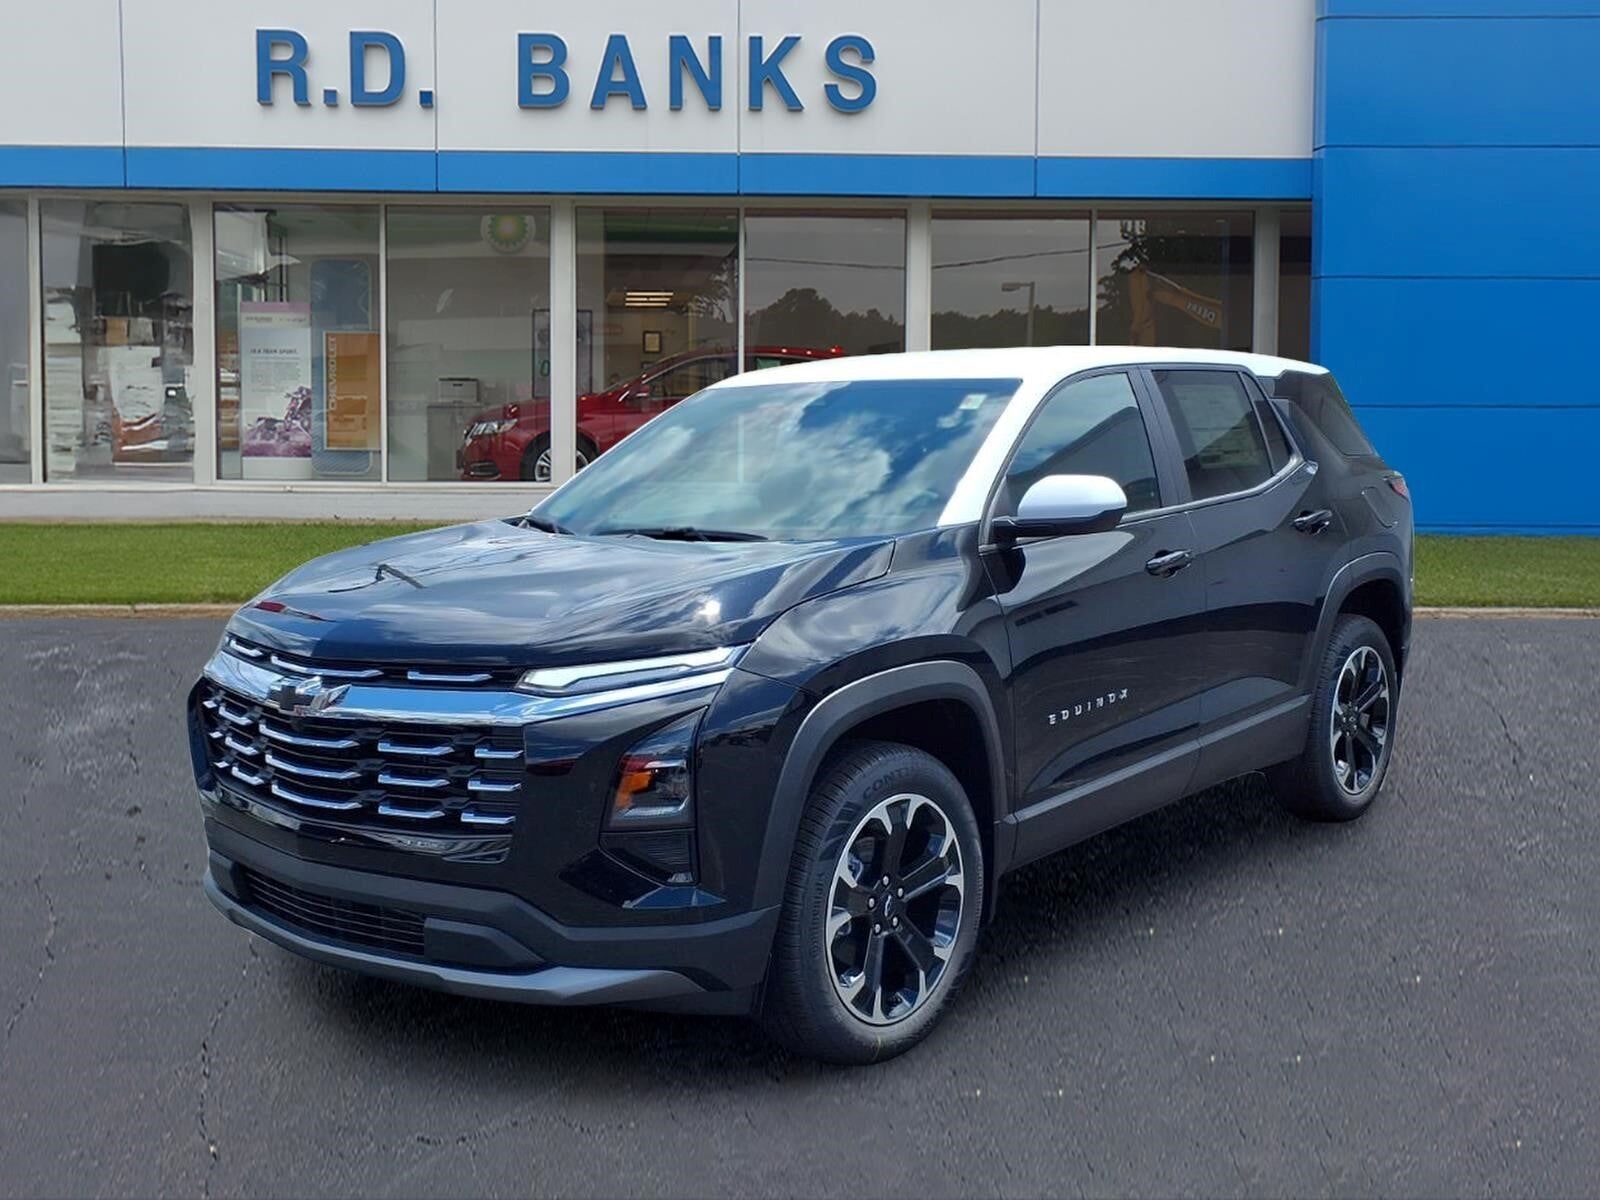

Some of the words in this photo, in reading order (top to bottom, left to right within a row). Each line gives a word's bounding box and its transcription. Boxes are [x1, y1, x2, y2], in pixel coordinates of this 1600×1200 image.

[256, 29, 433, 107] R.D.
[517, 33, 877, 112] BANKS
[328, 335, 336, 410] CHEVROLET
[1048, 688, 1128, 725] EQUINOX
